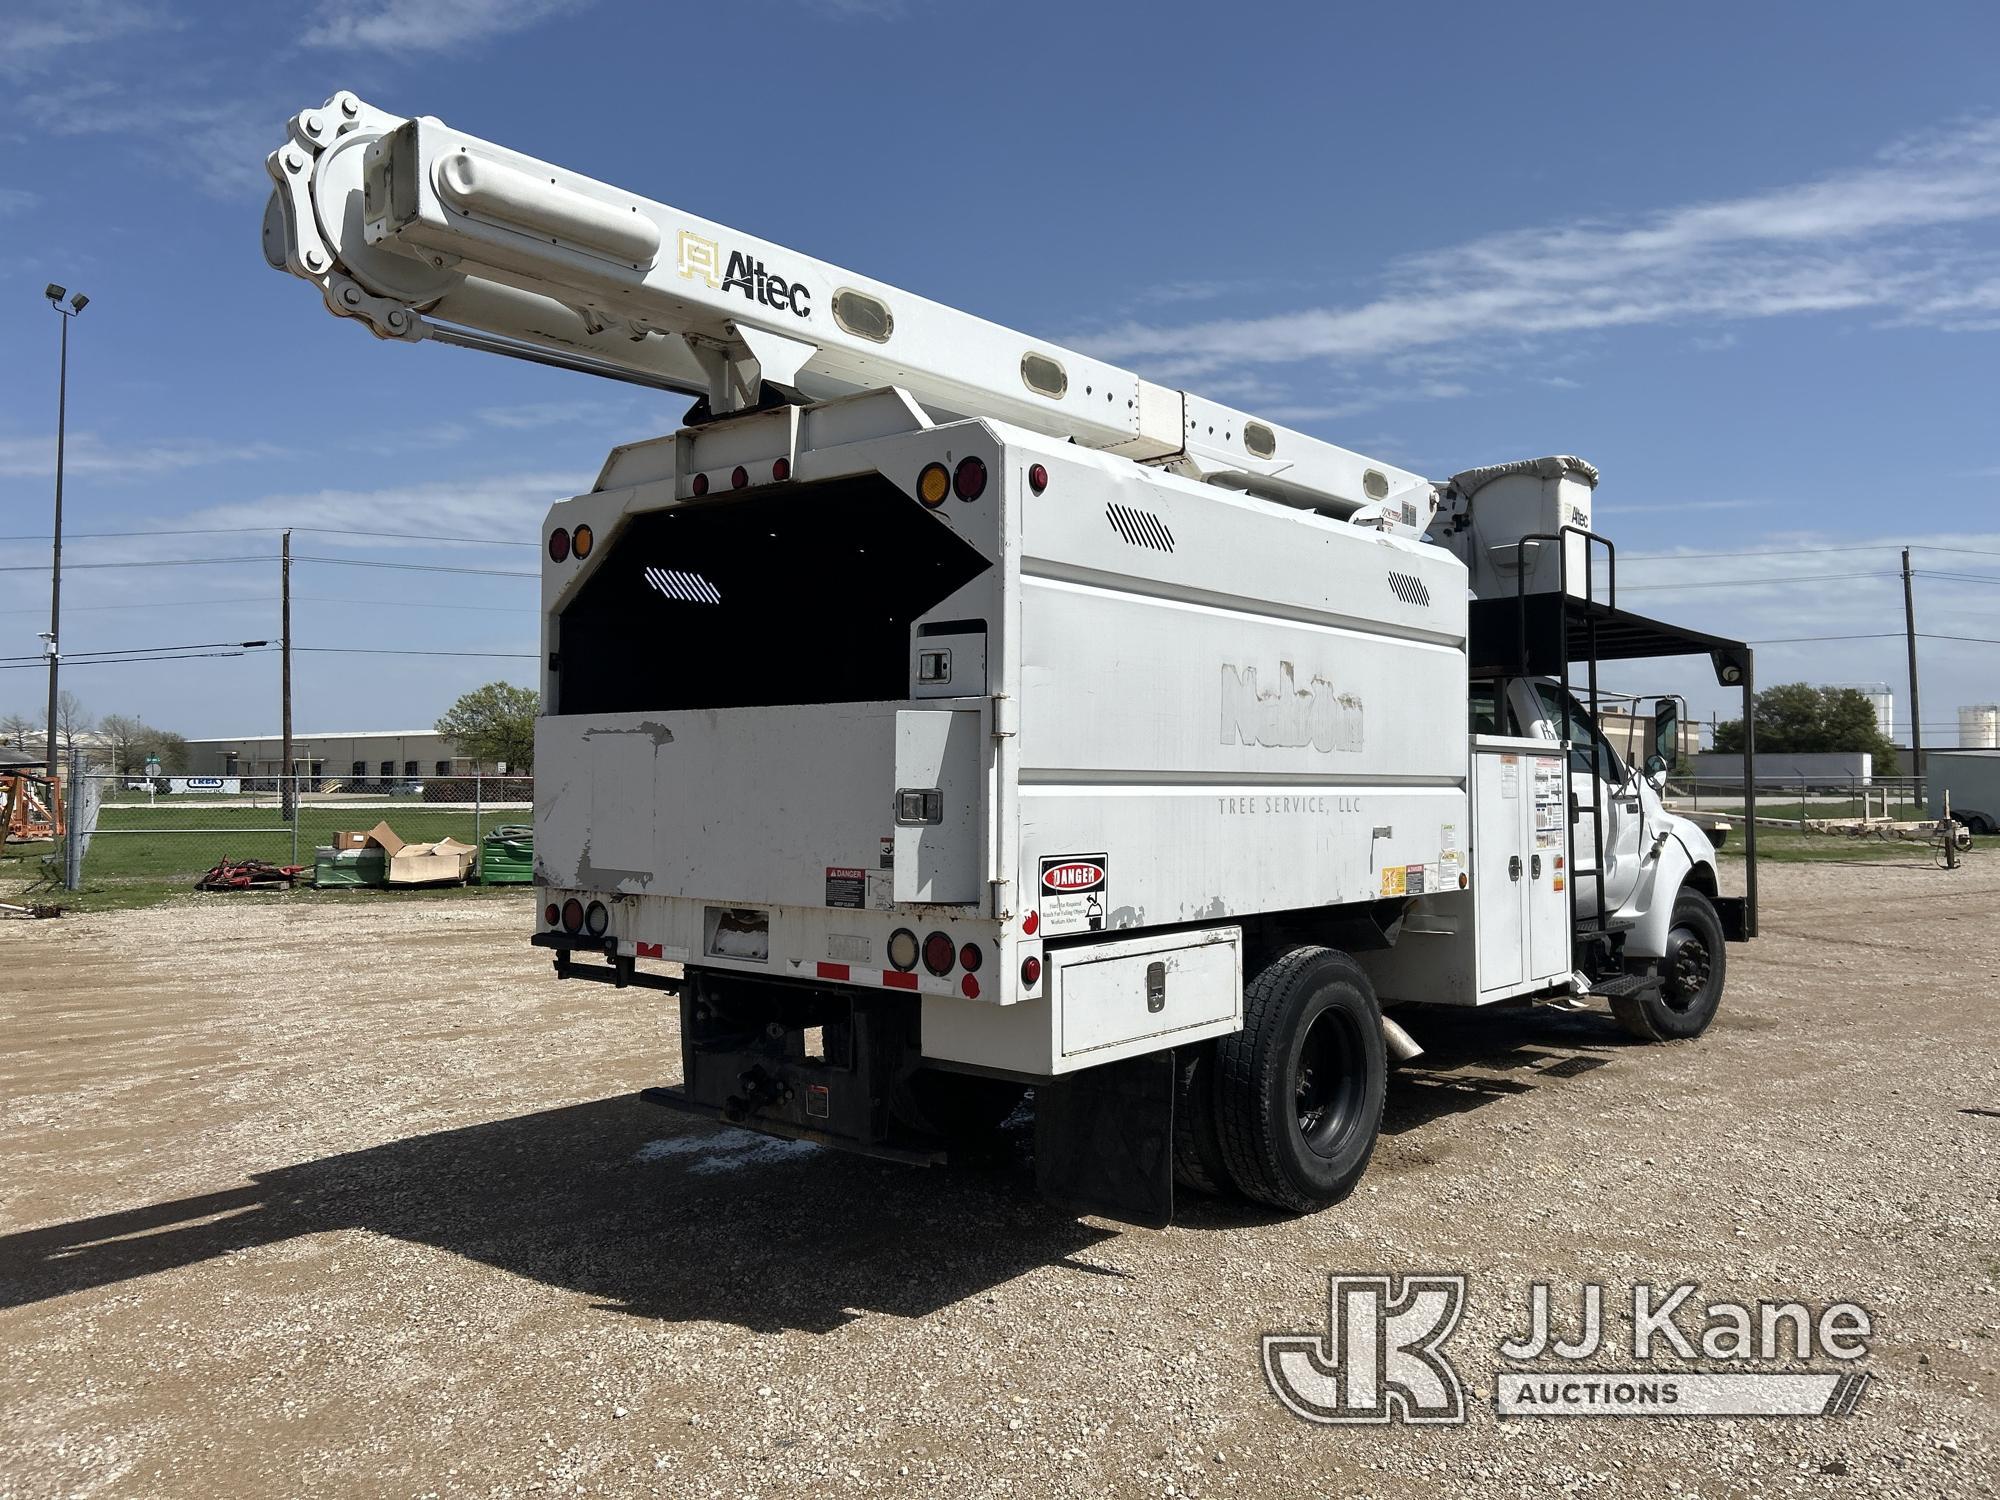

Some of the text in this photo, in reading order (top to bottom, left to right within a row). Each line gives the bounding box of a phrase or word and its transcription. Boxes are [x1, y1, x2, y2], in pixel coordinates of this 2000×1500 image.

[721, 250, 811, 318] Altec
[1572, 506, 1588, 528] Altec
[1218, 797, 1361, 816] TREE SERVICE, LLC
[836, 870, 862, 878] DANGER
[1053, 868, 1095, 886] DANGER
